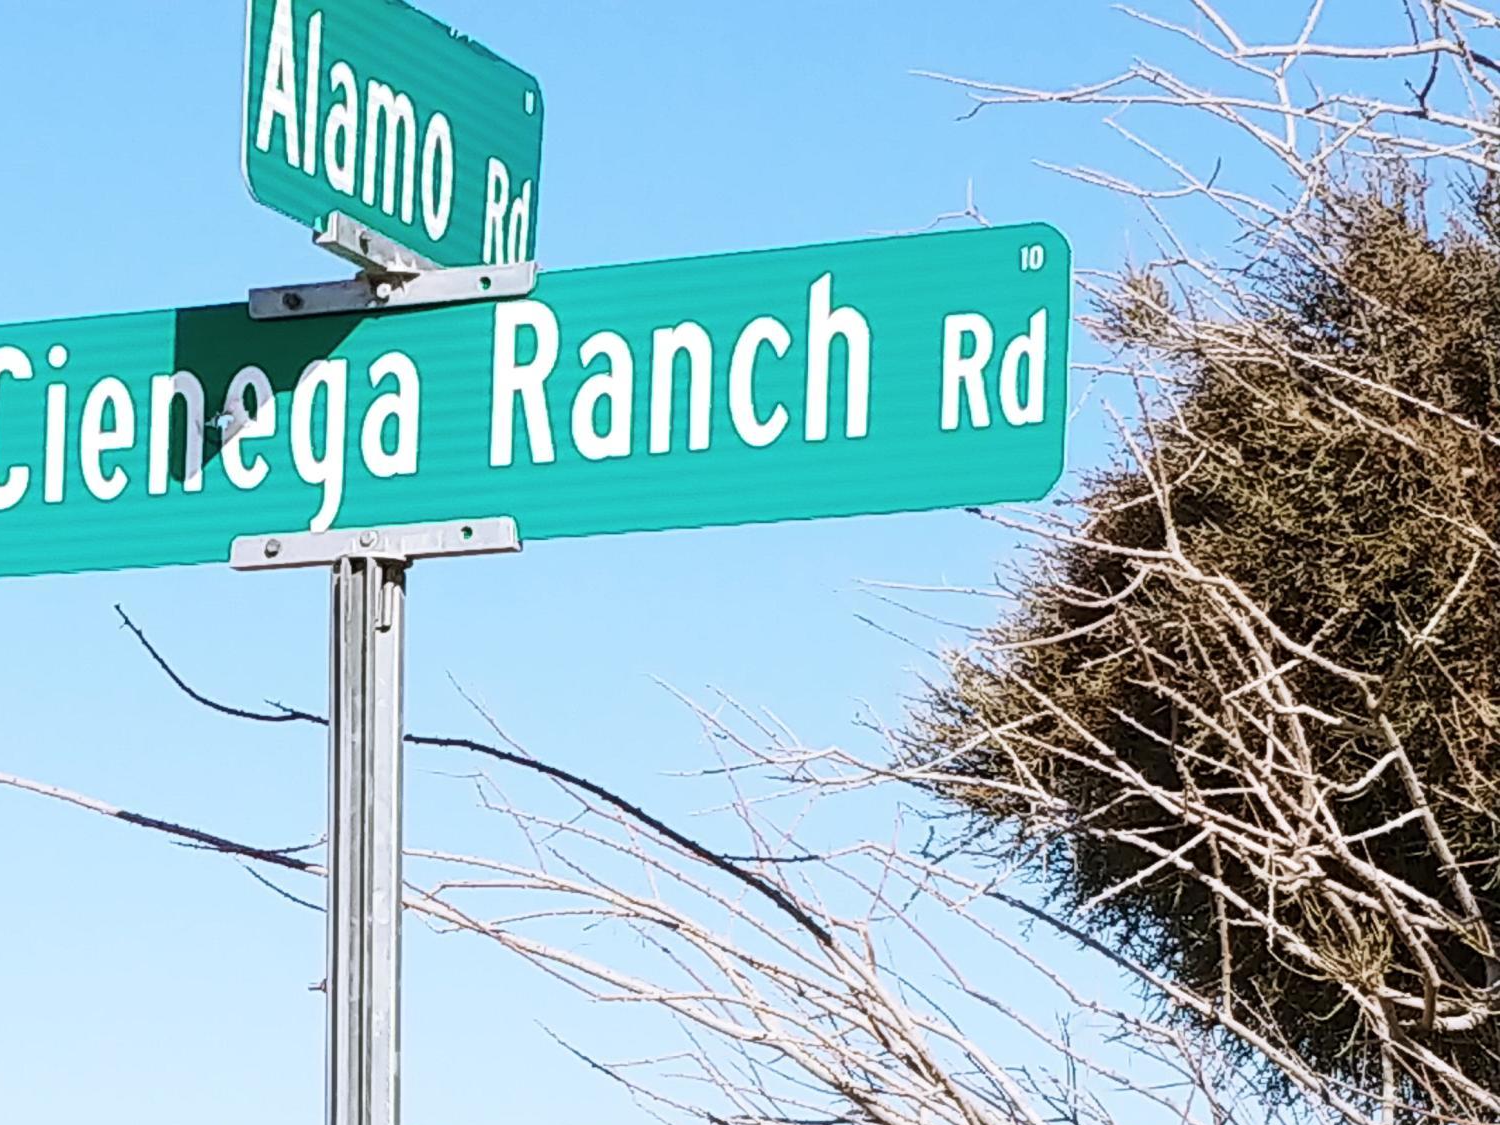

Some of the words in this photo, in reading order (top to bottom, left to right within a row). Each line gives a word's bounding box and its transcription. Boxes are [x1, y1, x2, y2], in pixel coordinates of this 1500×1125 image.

[255, 0, 453, 242] Alamo
[483, 156, 532, 265] Rd
[1020, 244, 1044, 271] 10
[489, 271, 872, 467] Ranch
[940, 307, 1048, 431] Rd
